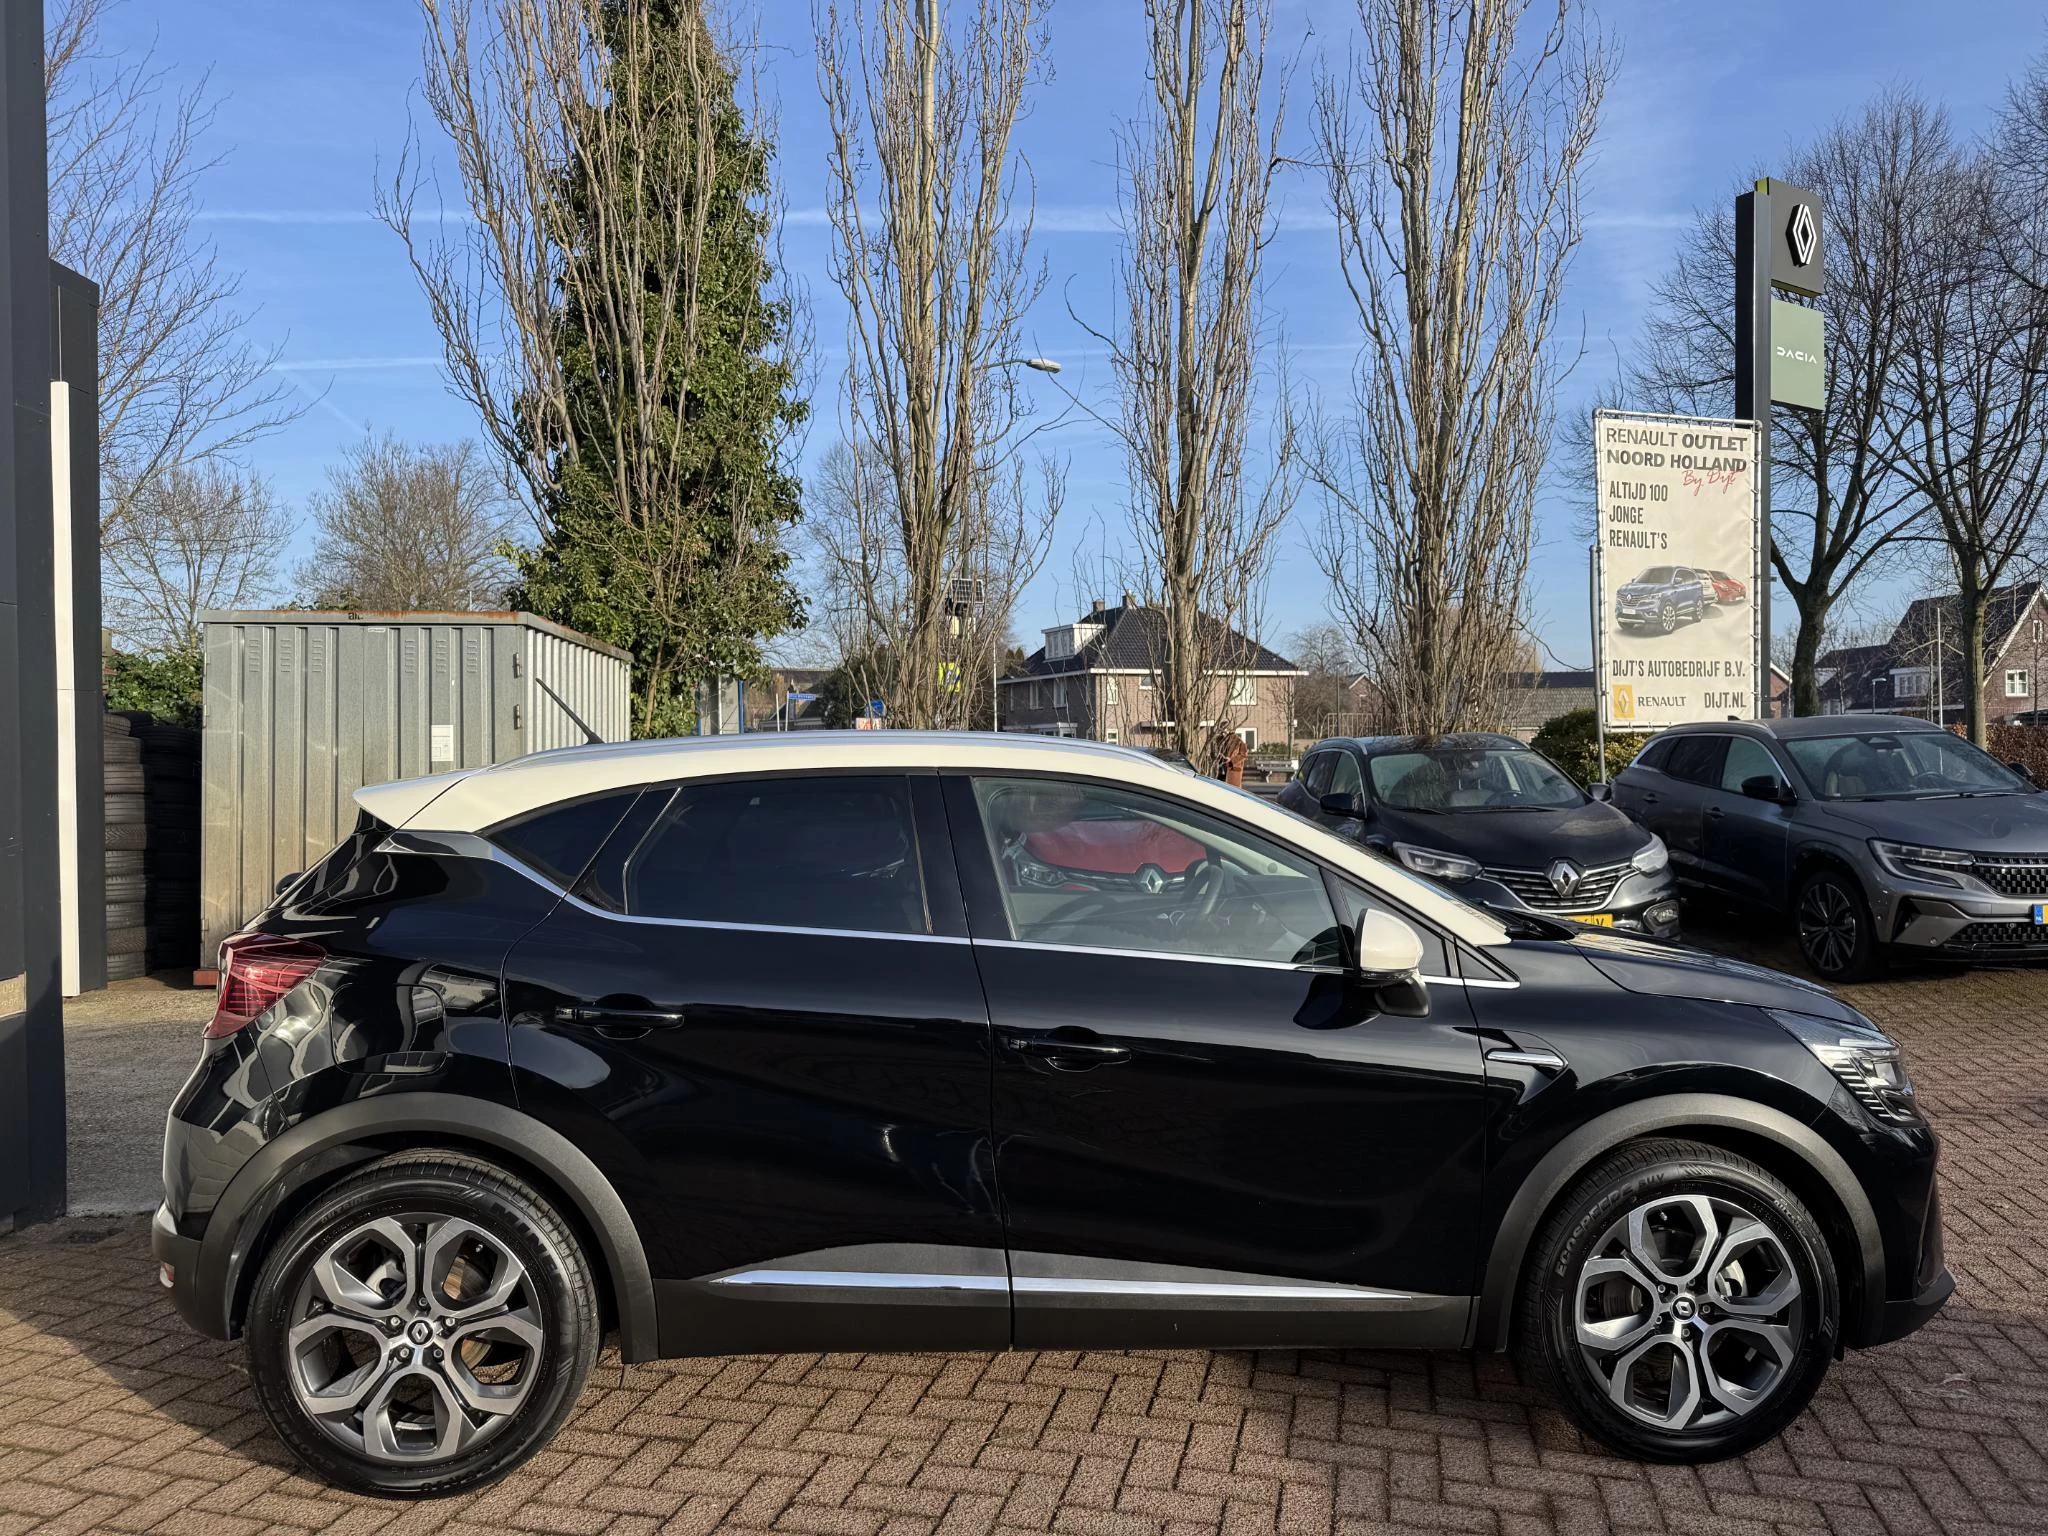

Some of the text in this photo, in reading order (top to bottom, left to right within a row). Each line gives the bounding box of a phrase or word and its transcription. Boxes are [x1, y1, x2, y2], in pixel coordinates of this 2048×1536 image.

[1776, 346, 1817, 364] DACIA
[1606, 427, 1748, 452] RENAULT OUTLET
[1606, 449, 1747, 472] NOORD HOLLAND
[1609, 480, 1668, 502] ALTIJD 100
[1682, 469, 1704, 496] By
[1609, 505, 1644, 525] JONGE
[1609, 529, 1668, 550] RENAULT'S
[1612, 659, 1746, 677] DIJT'S AUTOBEDRIJF B.V.
[1637, 696, 1687, 707] RENAULT
[1704, 692, 1747, 708] DIJT.NL
